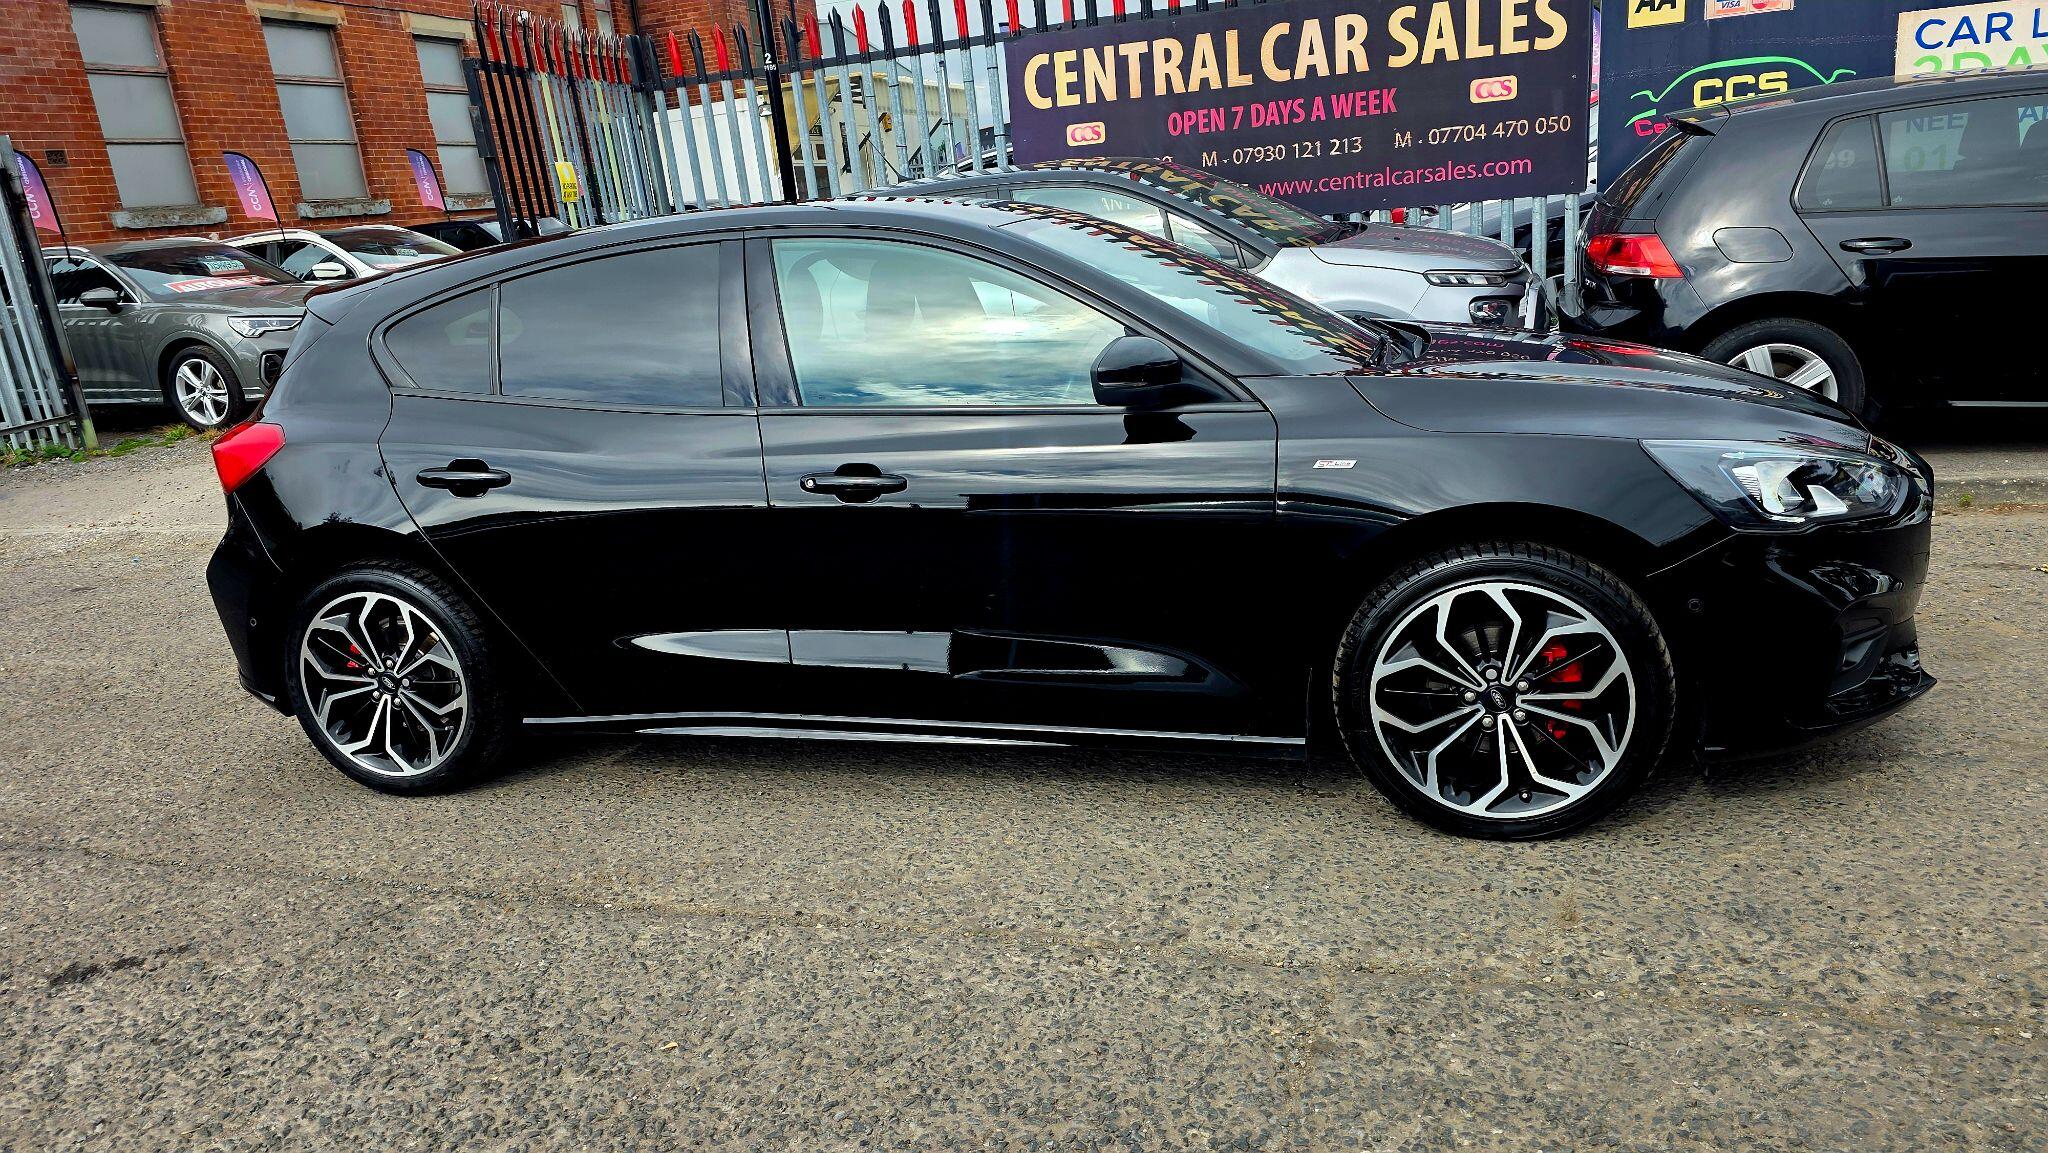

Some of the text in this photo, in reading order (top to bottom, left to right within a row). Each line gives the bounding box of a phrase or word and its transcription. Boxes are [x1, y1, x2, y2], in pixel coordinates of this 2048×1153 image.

[1915, 12, 2013, 50] CAR
[764, 52, 772, 64] 2
[1024, 29, 1254, 110] CENTRAL
[1260, 13, 1370, 82] CAR
[1387, 0, 1568, 68] SALES
[1474, 79, 1512, 99] CCS
[1693, 71, 1788, 108] CCS
[1167, 87, 1398, 136] OPEN 7 DAYS A WEEK
[1070, 125, 1102, 143] CCS
[1394, 115, 1571, 149] M 07704 470 050
[1202, 150, 1218, 168] M
[1232, 146, 1286, 165] 07930
[1292, 141, 1321, 159] 121
[1329, 136, 1363, 155] 213
[1257, 157, 1532, 197] www.centralcarsales.com
